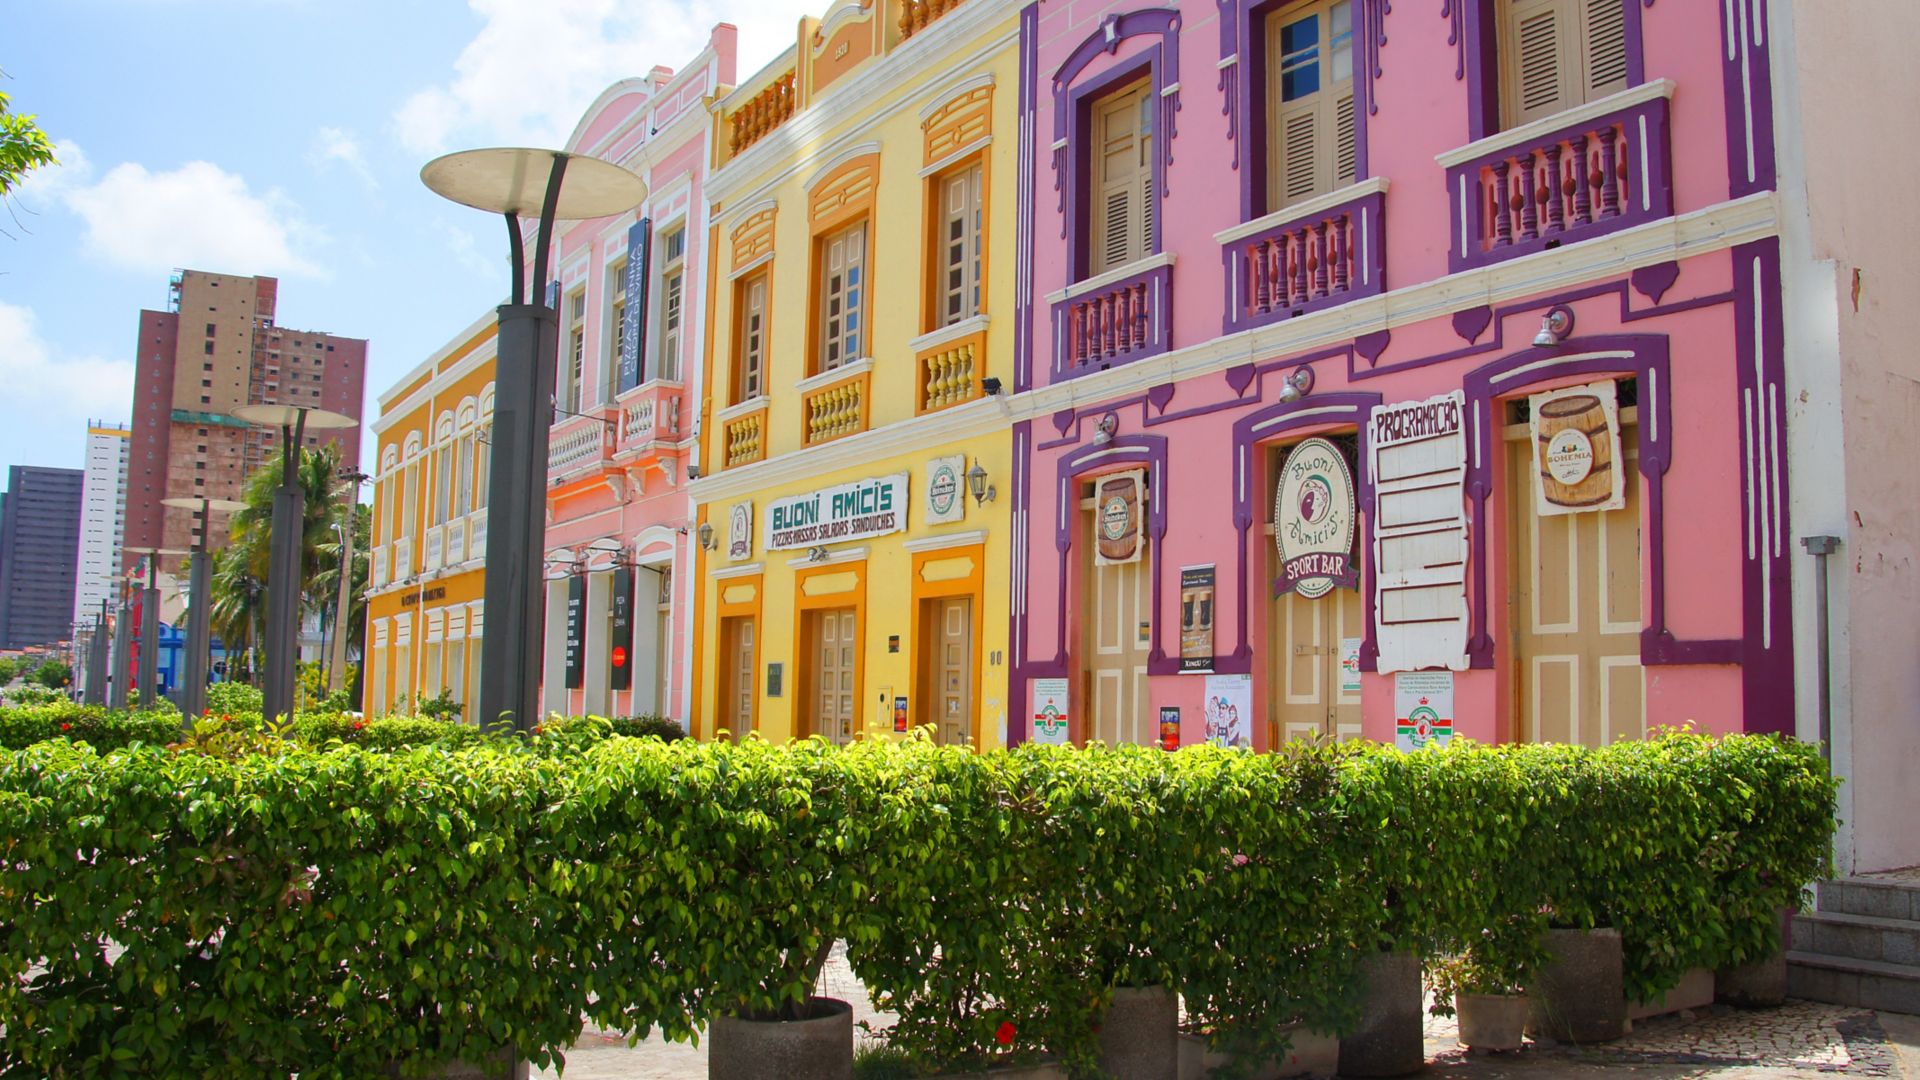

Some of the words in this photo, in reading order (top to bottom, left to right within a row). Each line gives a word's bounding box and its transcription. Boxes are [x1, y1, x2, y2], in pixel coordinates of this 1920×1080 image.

[627, 247, 638, 307] LENHA
[635, 243, 643, 294] VINHO
[624, 329, 633, 376] PIZZA
[1376, 396, 1459, 443] PROGRAMAÇÃO
[1292, 451, 1335, 480] Buoni
[1548, 452, 1592, 463] BOHEMIA
[851, 512, 896, 534] SANDUICHES
[1286, 554, 1320, 581] SPORT
[1321, 554, 1343, 576] BAR
